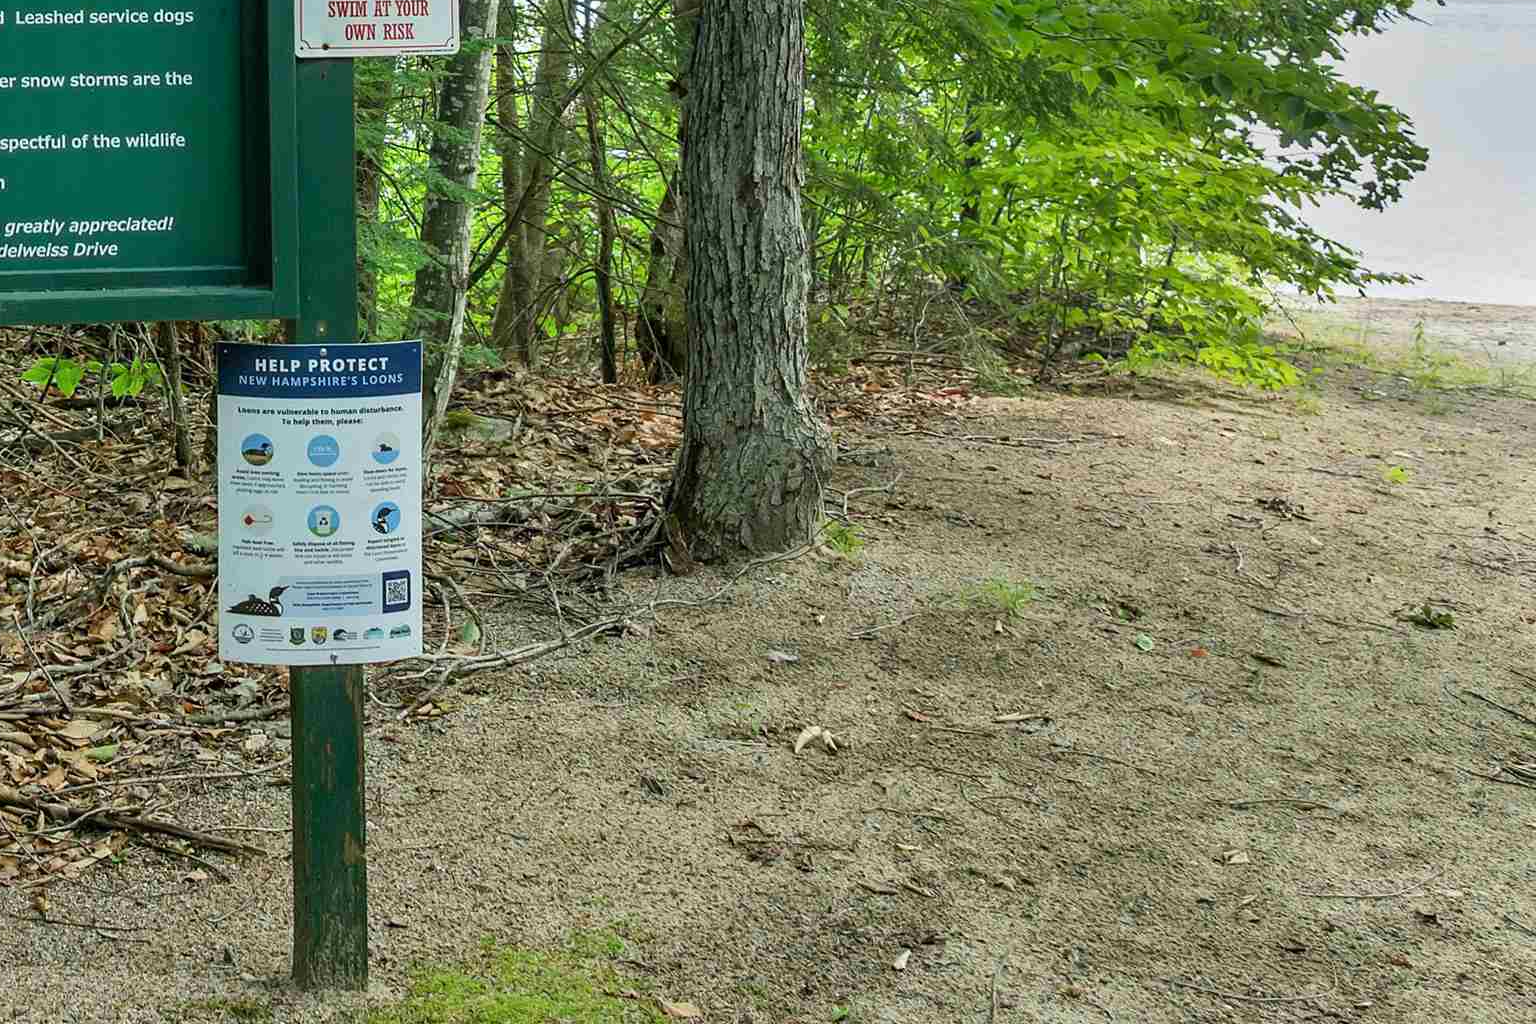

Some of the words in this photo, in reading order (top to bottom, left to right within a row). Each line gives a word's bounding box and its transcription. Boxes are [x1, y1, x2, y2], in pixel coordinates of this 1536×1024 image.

[328, 0, 368, 18] SWIM
[374, 0, 390, 17] AT
[395, 0, 429, 17] YOUR
[345, 24, 378, 41] OWN
[383, 23, 415, 40] RISK
[20, 74, 65, 88] snow
[69, 72, 128, 87] storms
[132, 73, 160, 86] are
[164, 70, 192, 86] the
[3, 217, 65, 237] greatly
[68, 215, 174, 236] appreciated!
[72, 240, 118, 257] Drive
[255, 358, 301, 373] HELP
[308, 357, 389, 373] PROTECT
[239, 375, 268, 386] NEW
[271, 375, 358, 387] HAMPSHIRE'S
[362, 373, 404, 386] LOONS
